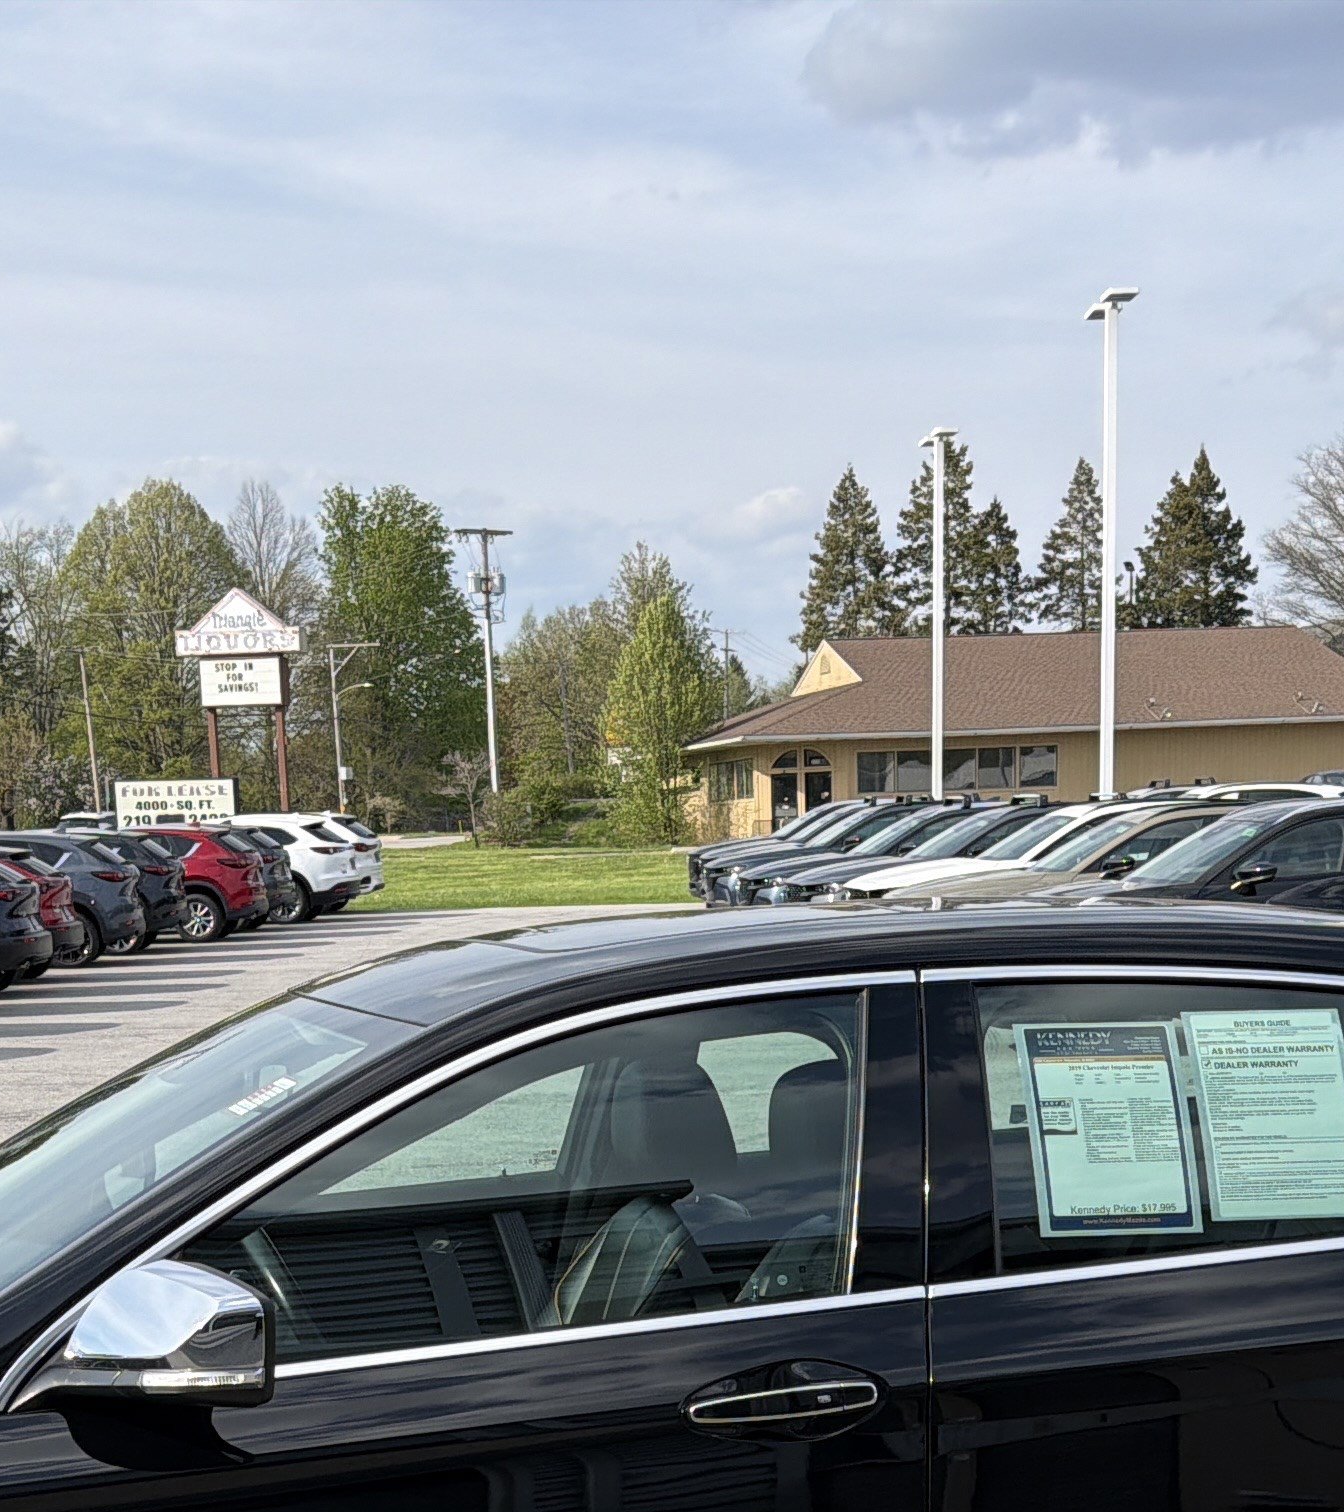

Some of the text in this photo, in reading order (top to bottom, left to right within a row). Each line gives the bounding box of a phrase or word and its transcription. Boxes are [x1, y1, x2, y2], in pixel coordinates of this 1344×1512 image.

[211, 610, 267, 632] Triangle
[214, 662, 254, 673] STOP IN
[226, 672, 244, 682] FOR
[121, 784, 228, 797] FOR LEASE
[123, 814, 152, 827] 219
[1036, 1030, 1112, 1047] KENNEDY
[1211, 1047, 1224, 1056] AS
[1251, 1045, 1285, 1055] DEALER
[1286, 1044, 1335, 1054] WARRANTY
[1214, 1060, 1299, 1070] DEALER WARRANTY
[1071, 1205, 1111, 1216] Kennedy
[1113, 1203, 1139, 1213] Price:
